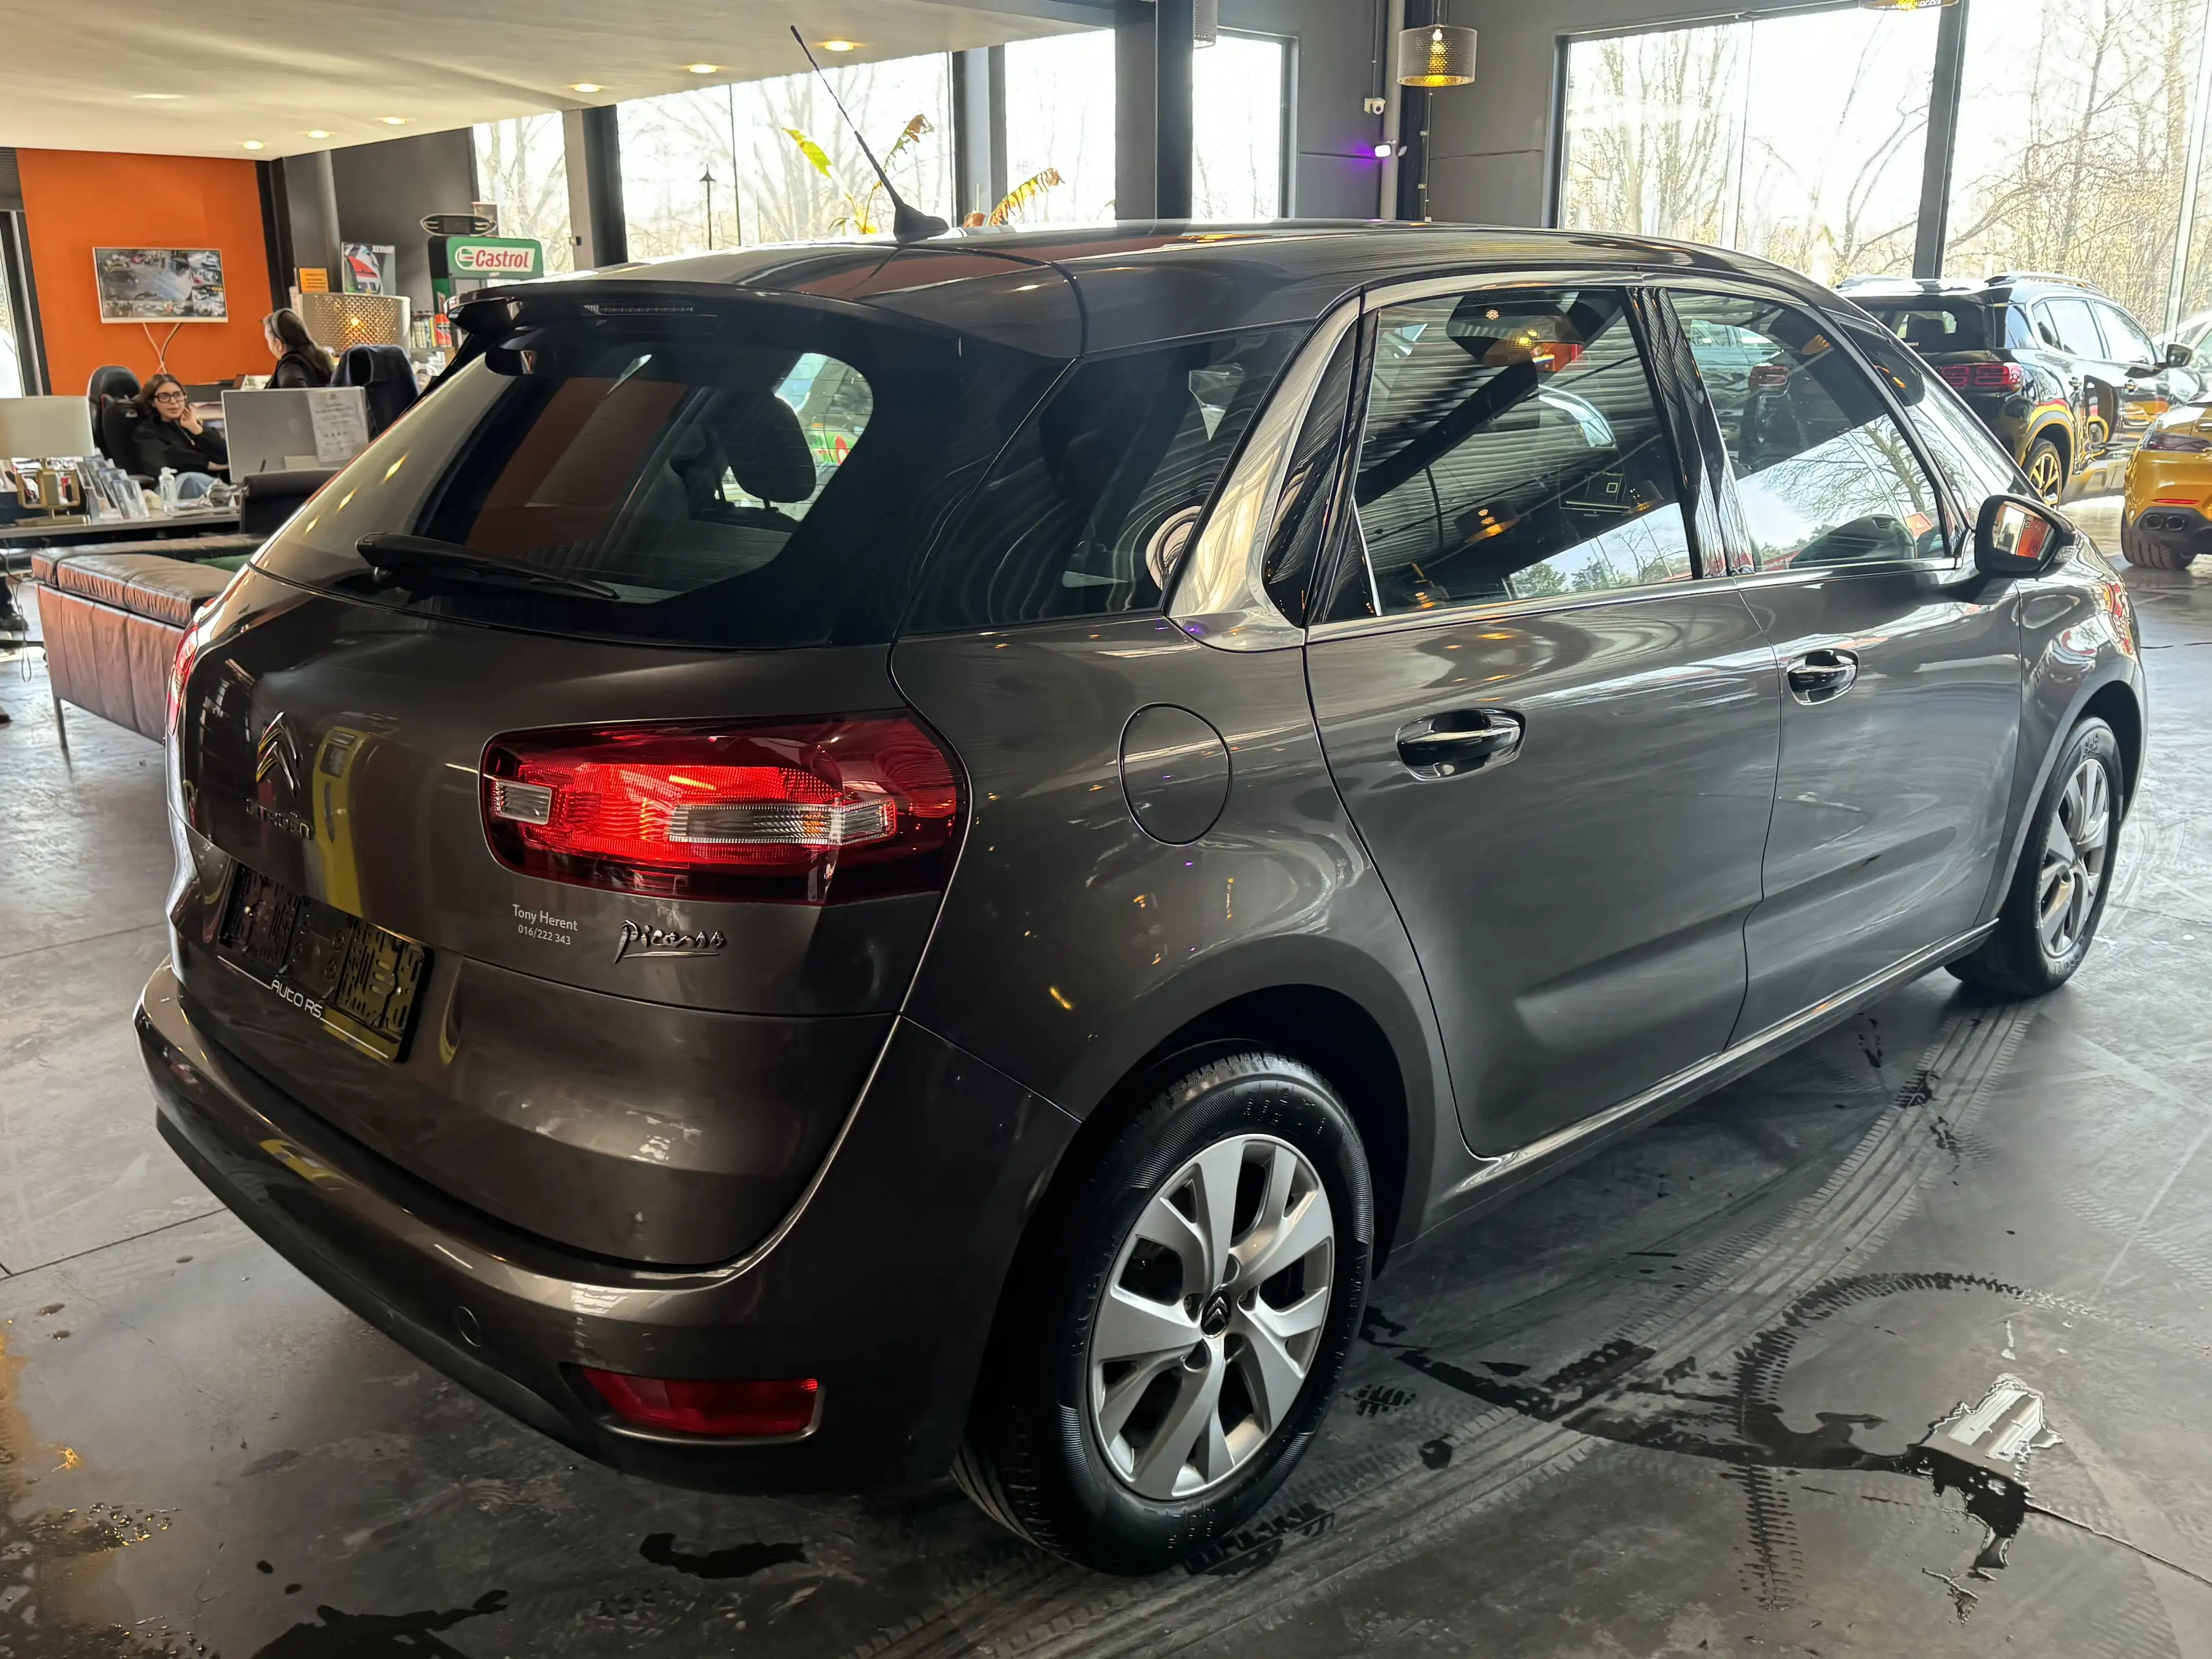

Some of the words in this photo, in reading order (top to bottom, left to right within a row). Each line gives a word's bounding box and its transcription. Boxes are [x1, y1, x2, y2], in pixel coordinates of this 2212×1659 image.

[476, 249, 529, 268] Castrol
[512, 904, 537, 925] Tony
[540, 910, 578, 931] Herent
[518, 925, 553, 941] 016/222
[555, 933, 571, 945] 343
[613, 920, 726, 964] Picasso
[304, 998, 323, 1018] RS
